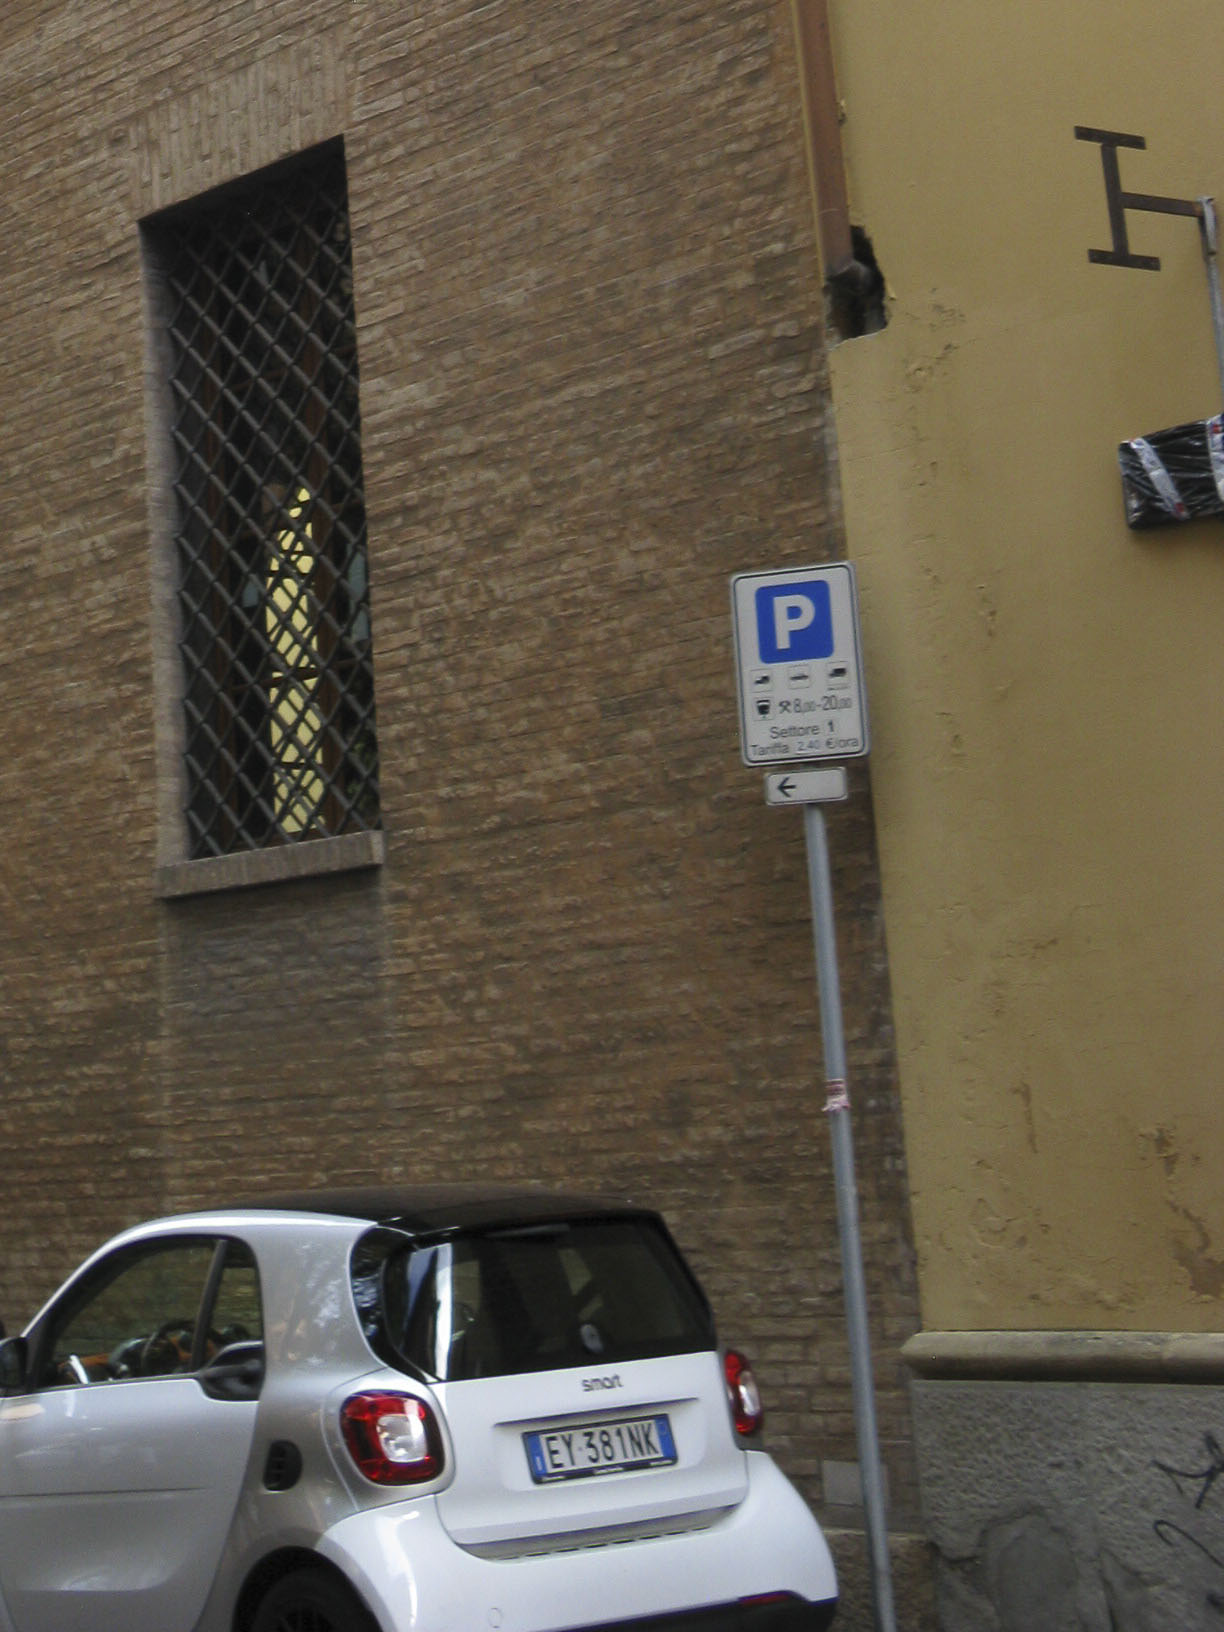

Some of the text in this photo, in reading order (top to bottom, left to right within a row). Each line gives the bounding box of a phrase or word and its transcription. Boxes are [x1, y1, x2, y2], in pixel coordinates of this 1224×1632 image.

[773, 594, 815, 649] P
[769, 720, 835, 740] Settore 1
[750, 741, 790, 756] Tariffa
[581, 1374, 624, 1392] smart
[545, 1433, 576, 1470] EY
[582, 1423, 660, 1465] 381NK
